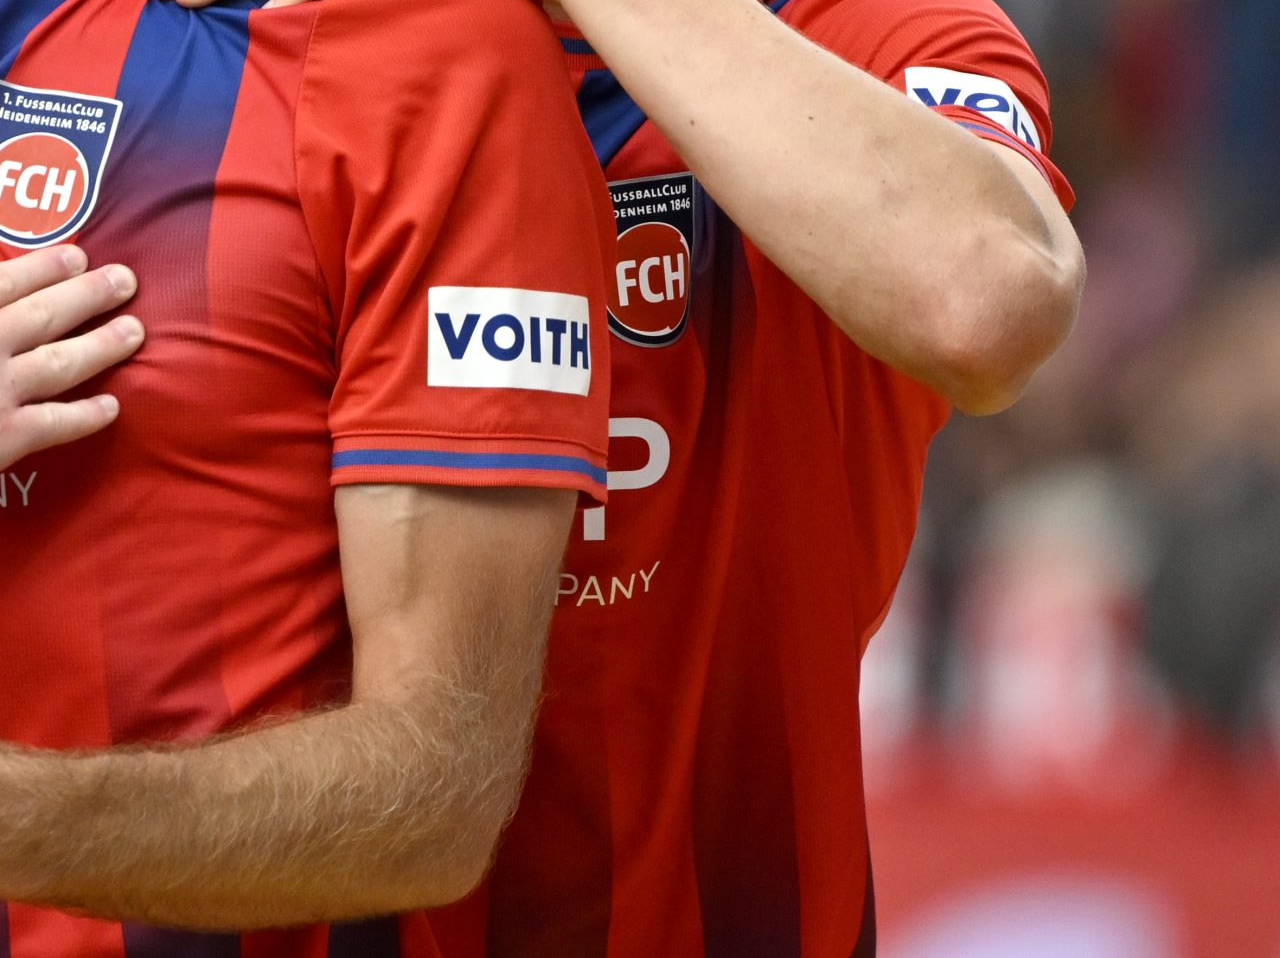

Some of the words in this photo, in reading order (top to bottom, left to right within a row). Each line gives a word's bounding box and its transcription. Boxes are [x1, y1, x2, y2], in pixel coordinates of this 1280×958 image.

[75, 118, 106, 134] 1846
[670, 197, 691, 212] 1846
[615, 252, 685, 307] FCH
[434, 312, 589, 370] VOITH
